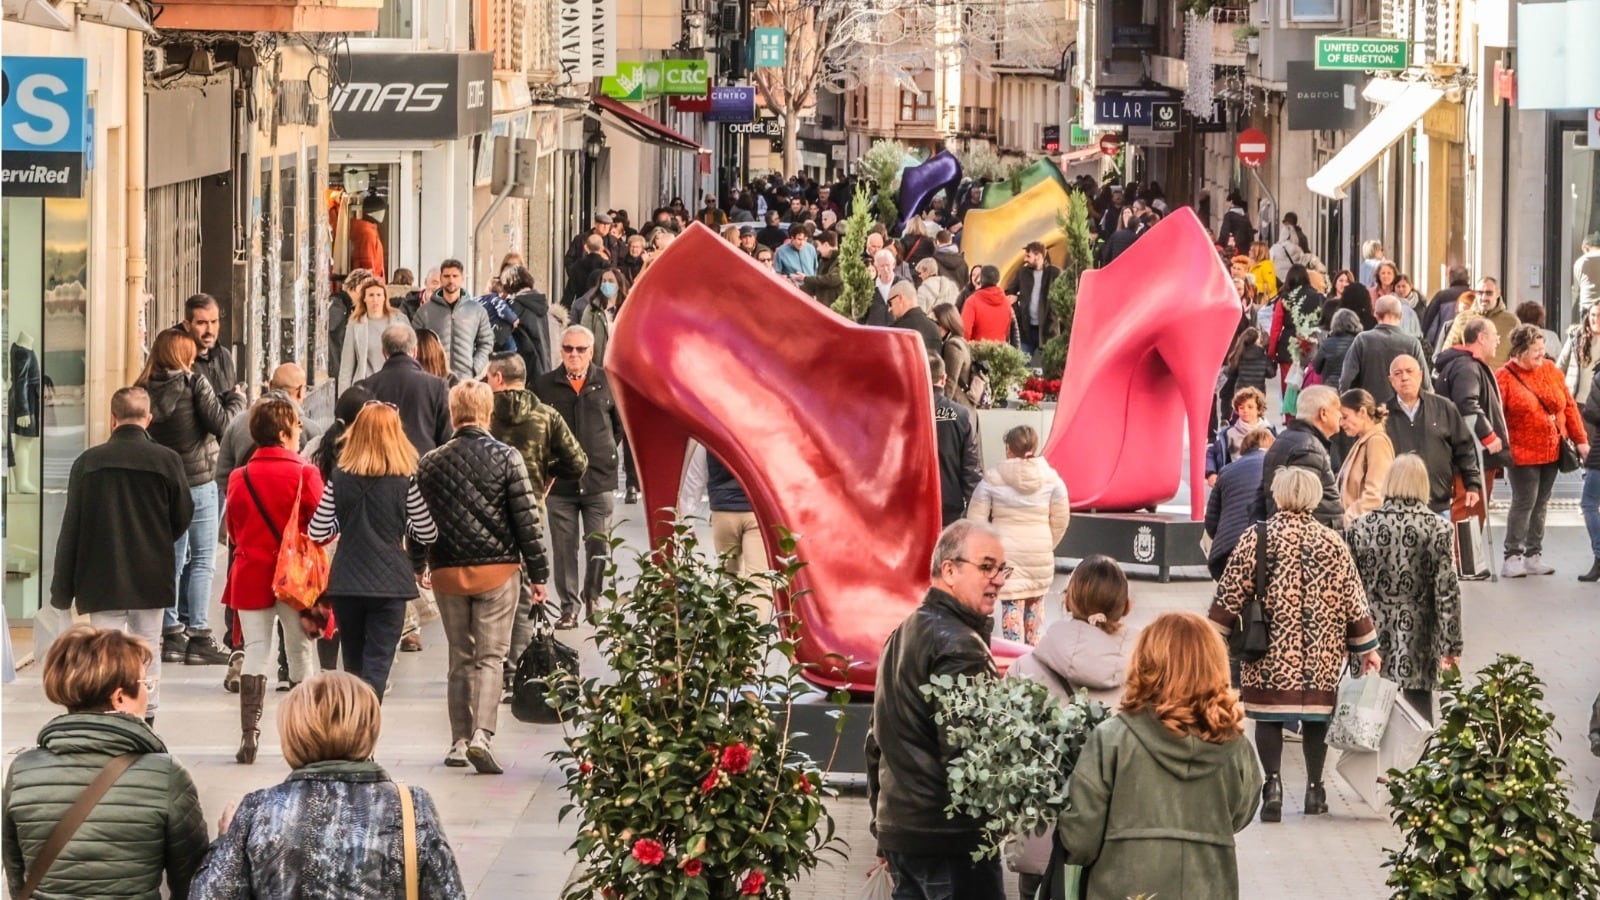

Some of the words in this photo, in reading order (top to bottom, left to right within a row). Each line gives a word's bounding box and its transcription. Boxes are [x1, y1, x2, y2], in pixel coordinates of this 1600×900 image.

[560, 0, 581, 74] MANG
[591, 0, 605, 68] MANG
[1323, 43, 1360, 53] UNITED
[1361, 44, 1400, 54] COLORS
[1327, 53, 1341, 63] OF
[666, 68, 706, 85] CRC
[711, 92, 747, 100] CENTRO
[1102, 101, 1142, 119] LLAR
